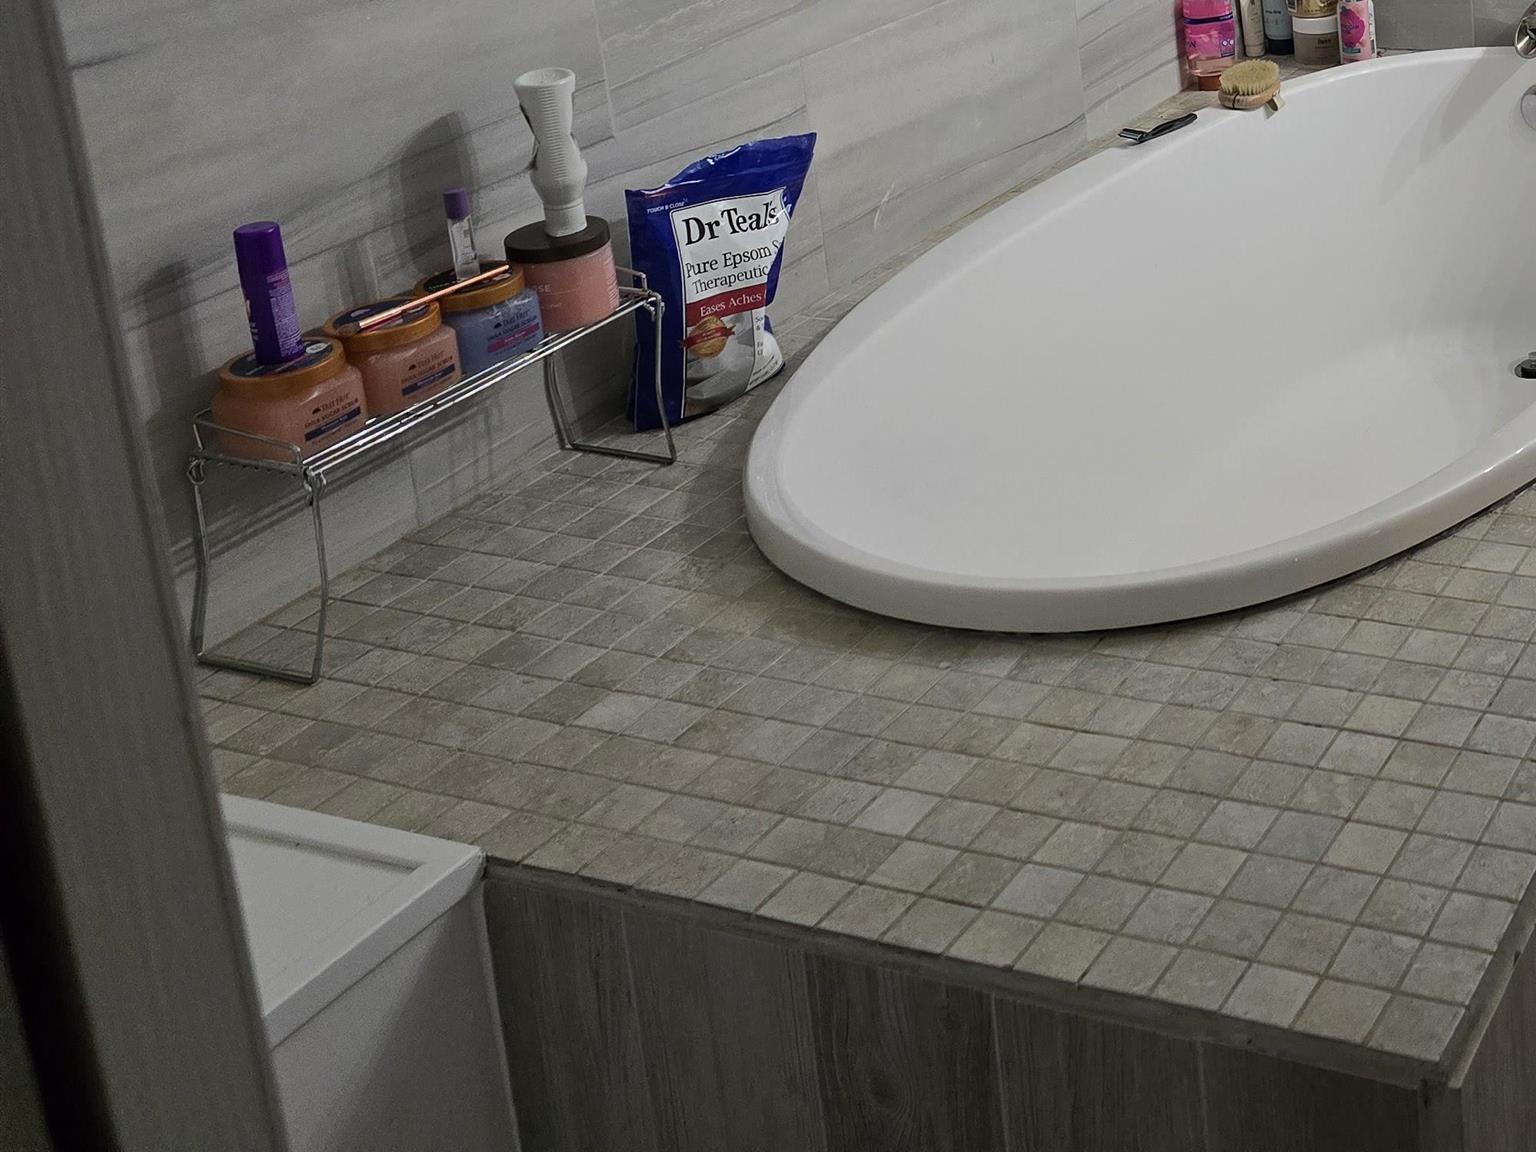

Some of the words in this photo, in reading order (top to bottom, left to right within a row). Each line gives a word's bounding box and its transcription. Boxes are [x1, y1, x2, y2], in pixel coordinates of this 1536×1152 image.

[647, 206, 665, 215] TOUCH
[682, 216, 720, 246] Dr
[721, 201, 779, 234] Teal's
[686, 259, 718, 278] Pure
[722, 246, 772, 269] Epsom
[692, 265, 769, 294] Therapeutic
[700, 301, 726, 317] Eases
[728, 293, 762, 308] Aches
